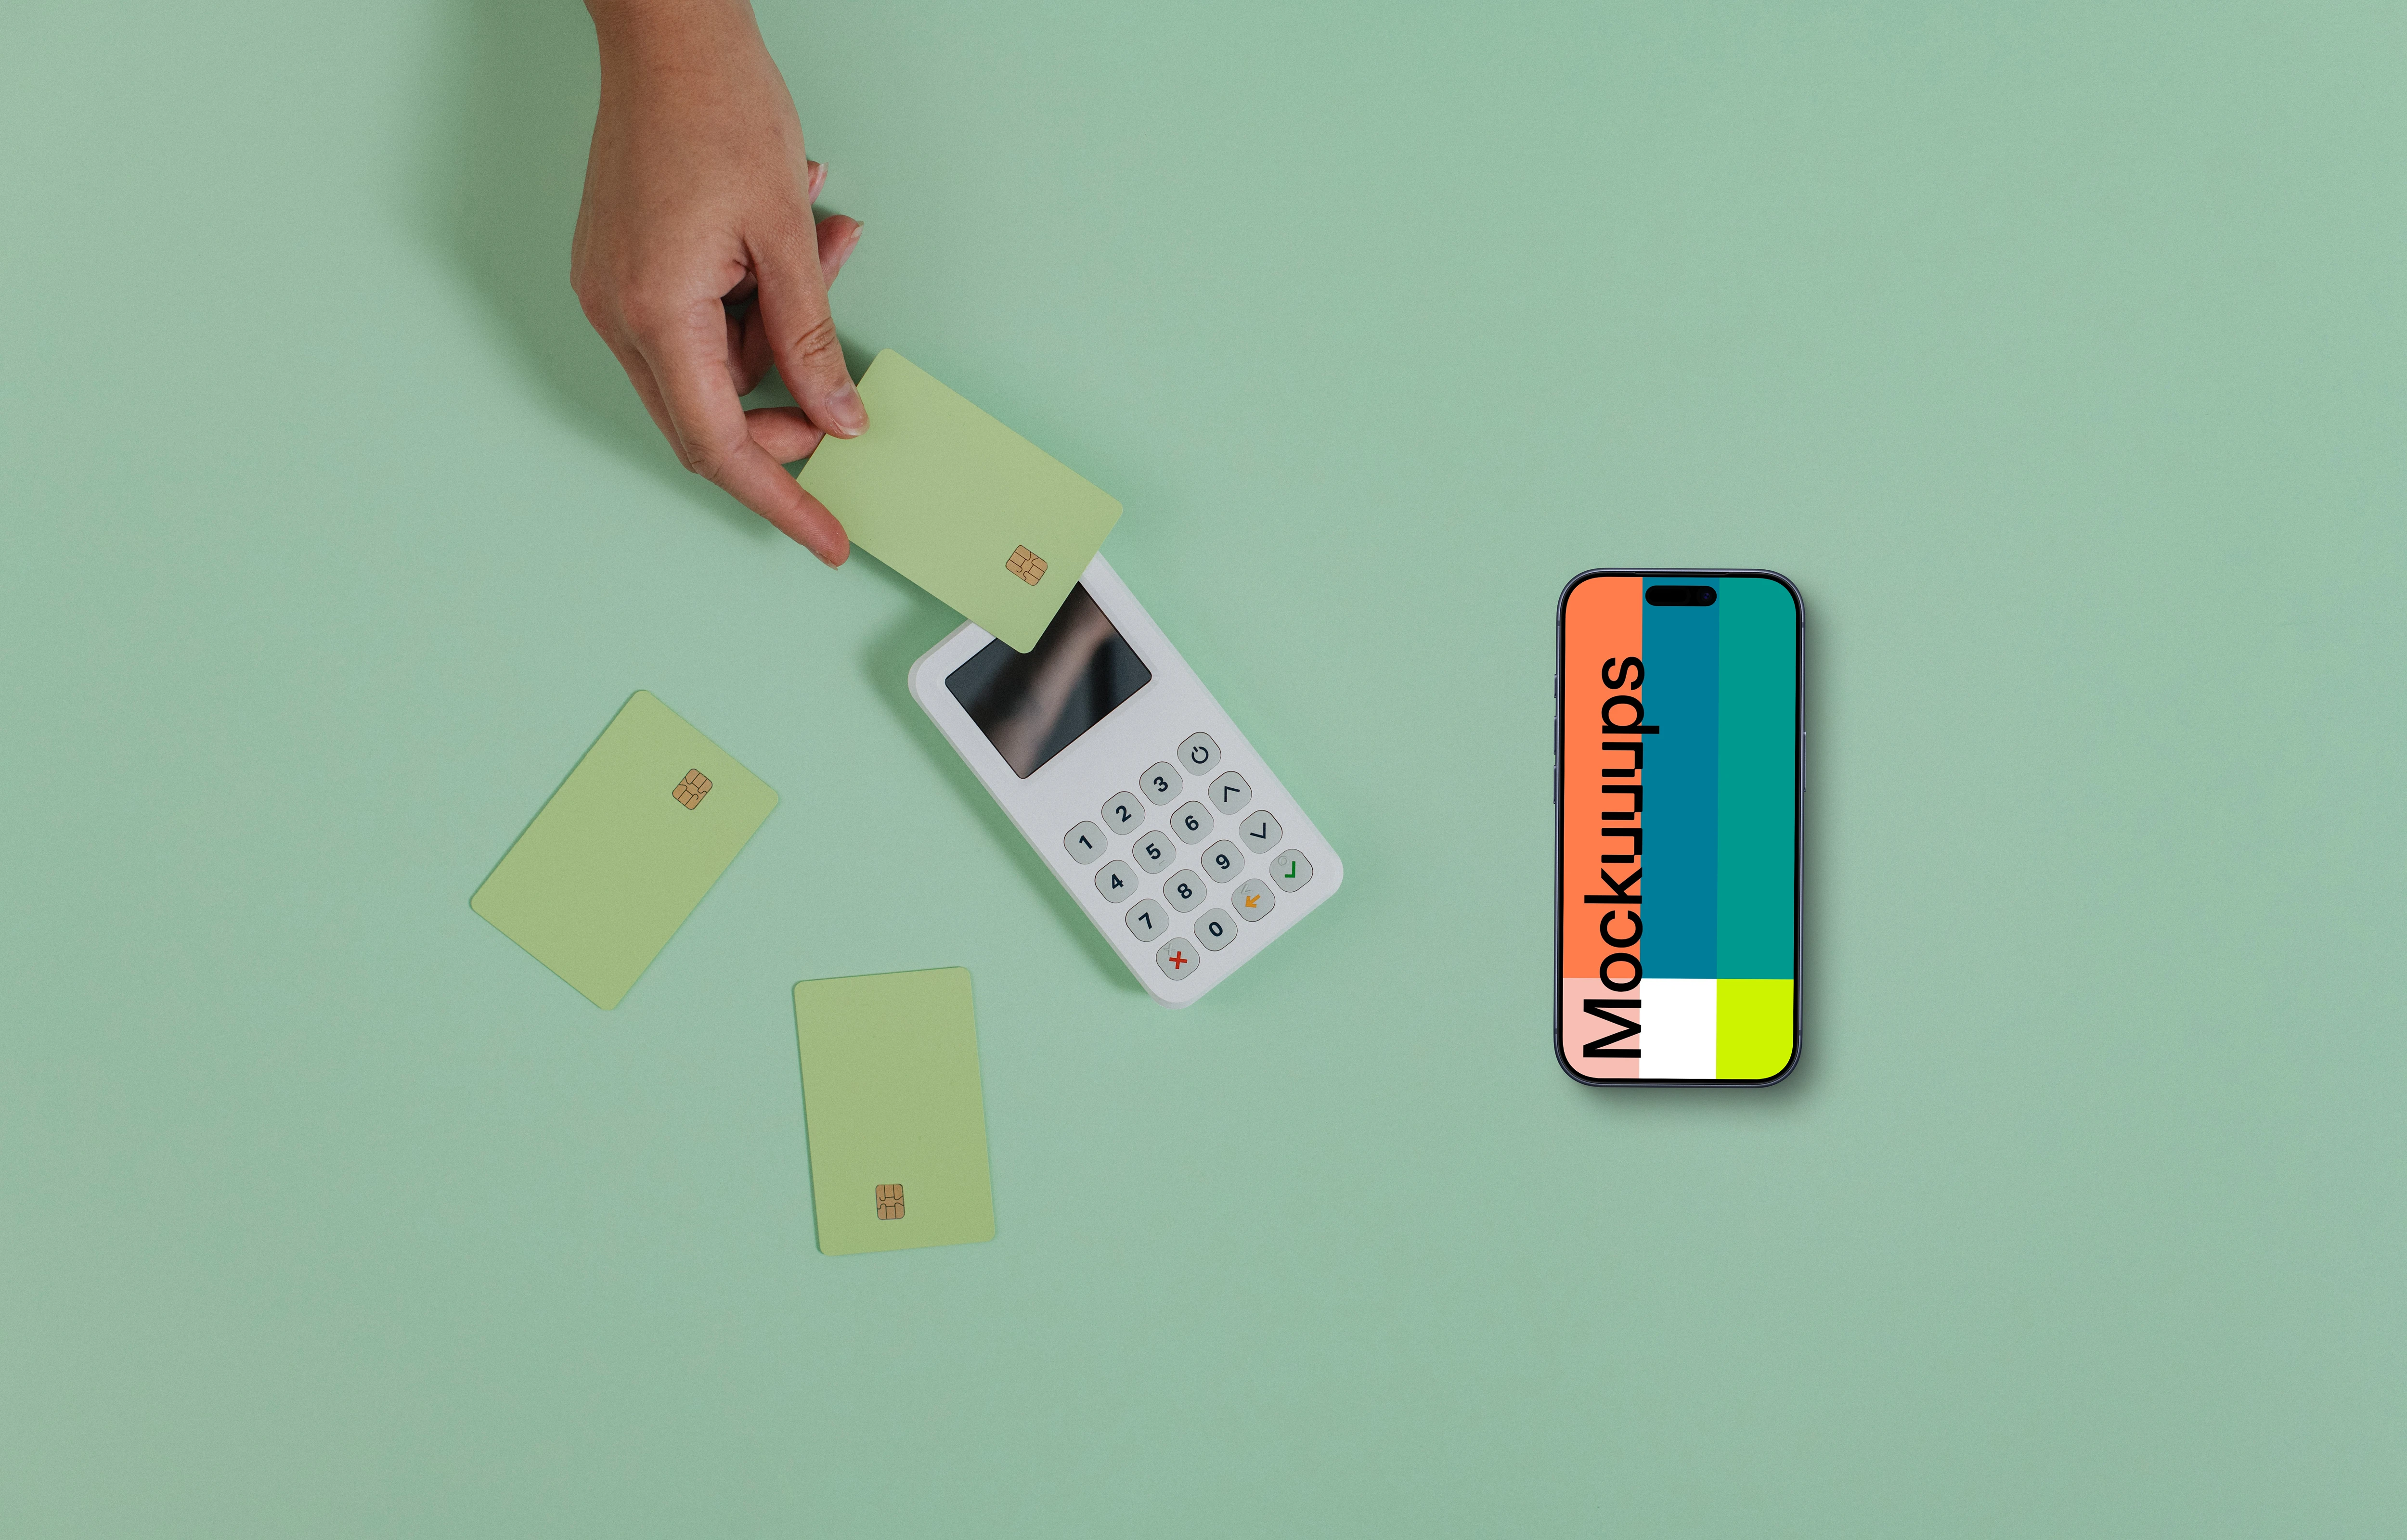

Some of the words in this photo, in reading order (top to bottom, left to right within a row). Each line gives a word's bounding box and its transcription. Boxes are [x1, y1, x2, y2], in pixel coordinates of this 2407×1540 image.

[1079, 834, 1093, 849] 1
[1115, 805, 1132, 823] 2
[1153, 776, 1168, 792] 3
[1112, 873, 1124, 889] 4
[1145, 843, 1161, 860] 5
[1185, 815, 1199, 831] 6
[1583, 656, 1660, 1058] Mockuuups
[1138, 911, 1152, 930] 7
[1177, 883, 1192, 899] 8
[1216, 854, 1230, 870] 9
[1209, 922, 1223, 937] 0
